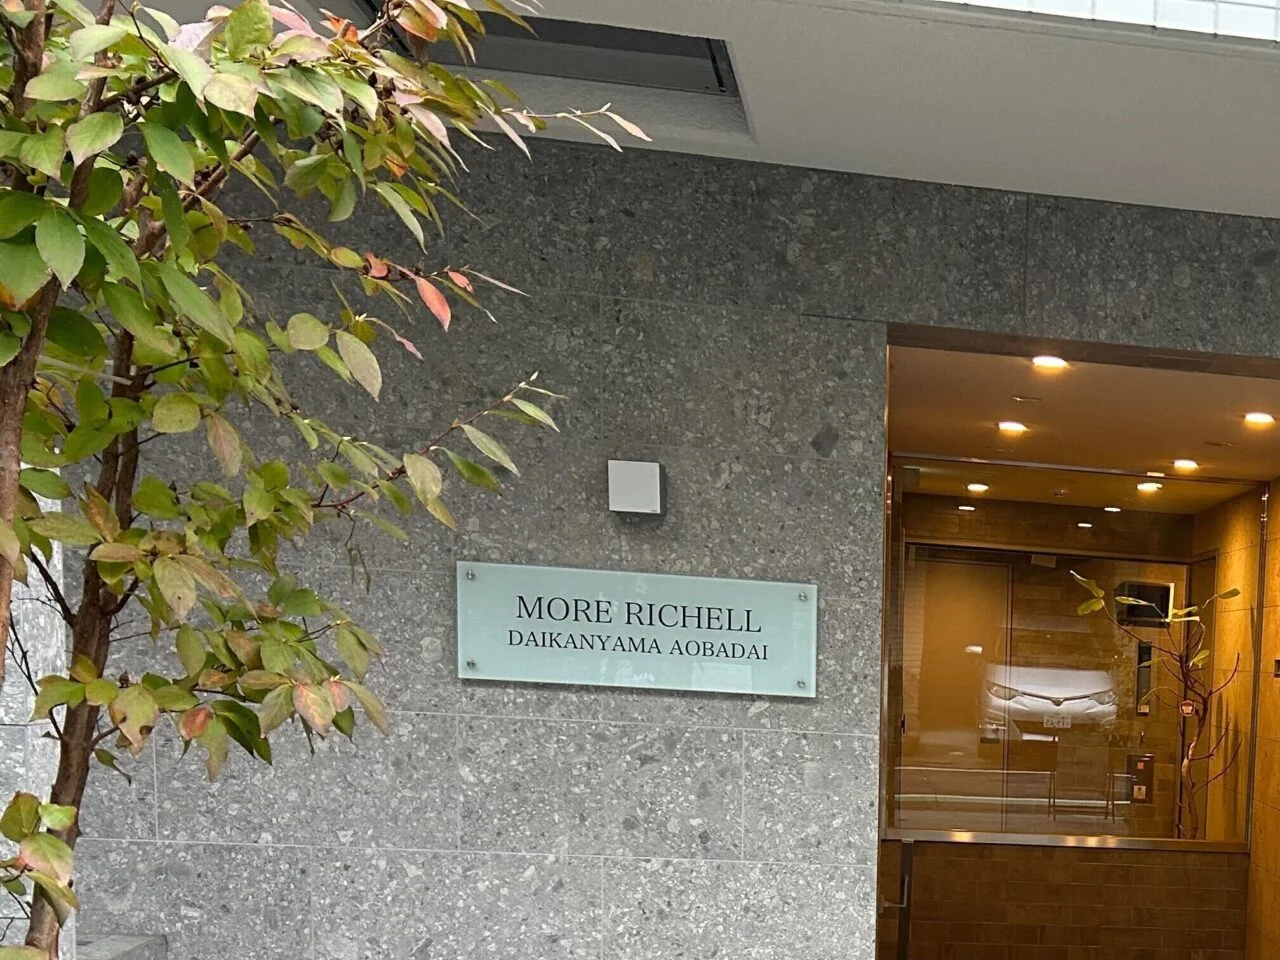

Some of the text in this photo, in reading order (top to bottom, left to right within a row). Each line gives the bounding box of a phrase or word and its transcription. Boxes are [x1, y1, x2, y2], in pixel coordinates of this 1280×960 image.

[516, 595, 762, 633] MORE RICHELL
[507, 629, 769, 661] DAIKANYAMA AOBADAI
